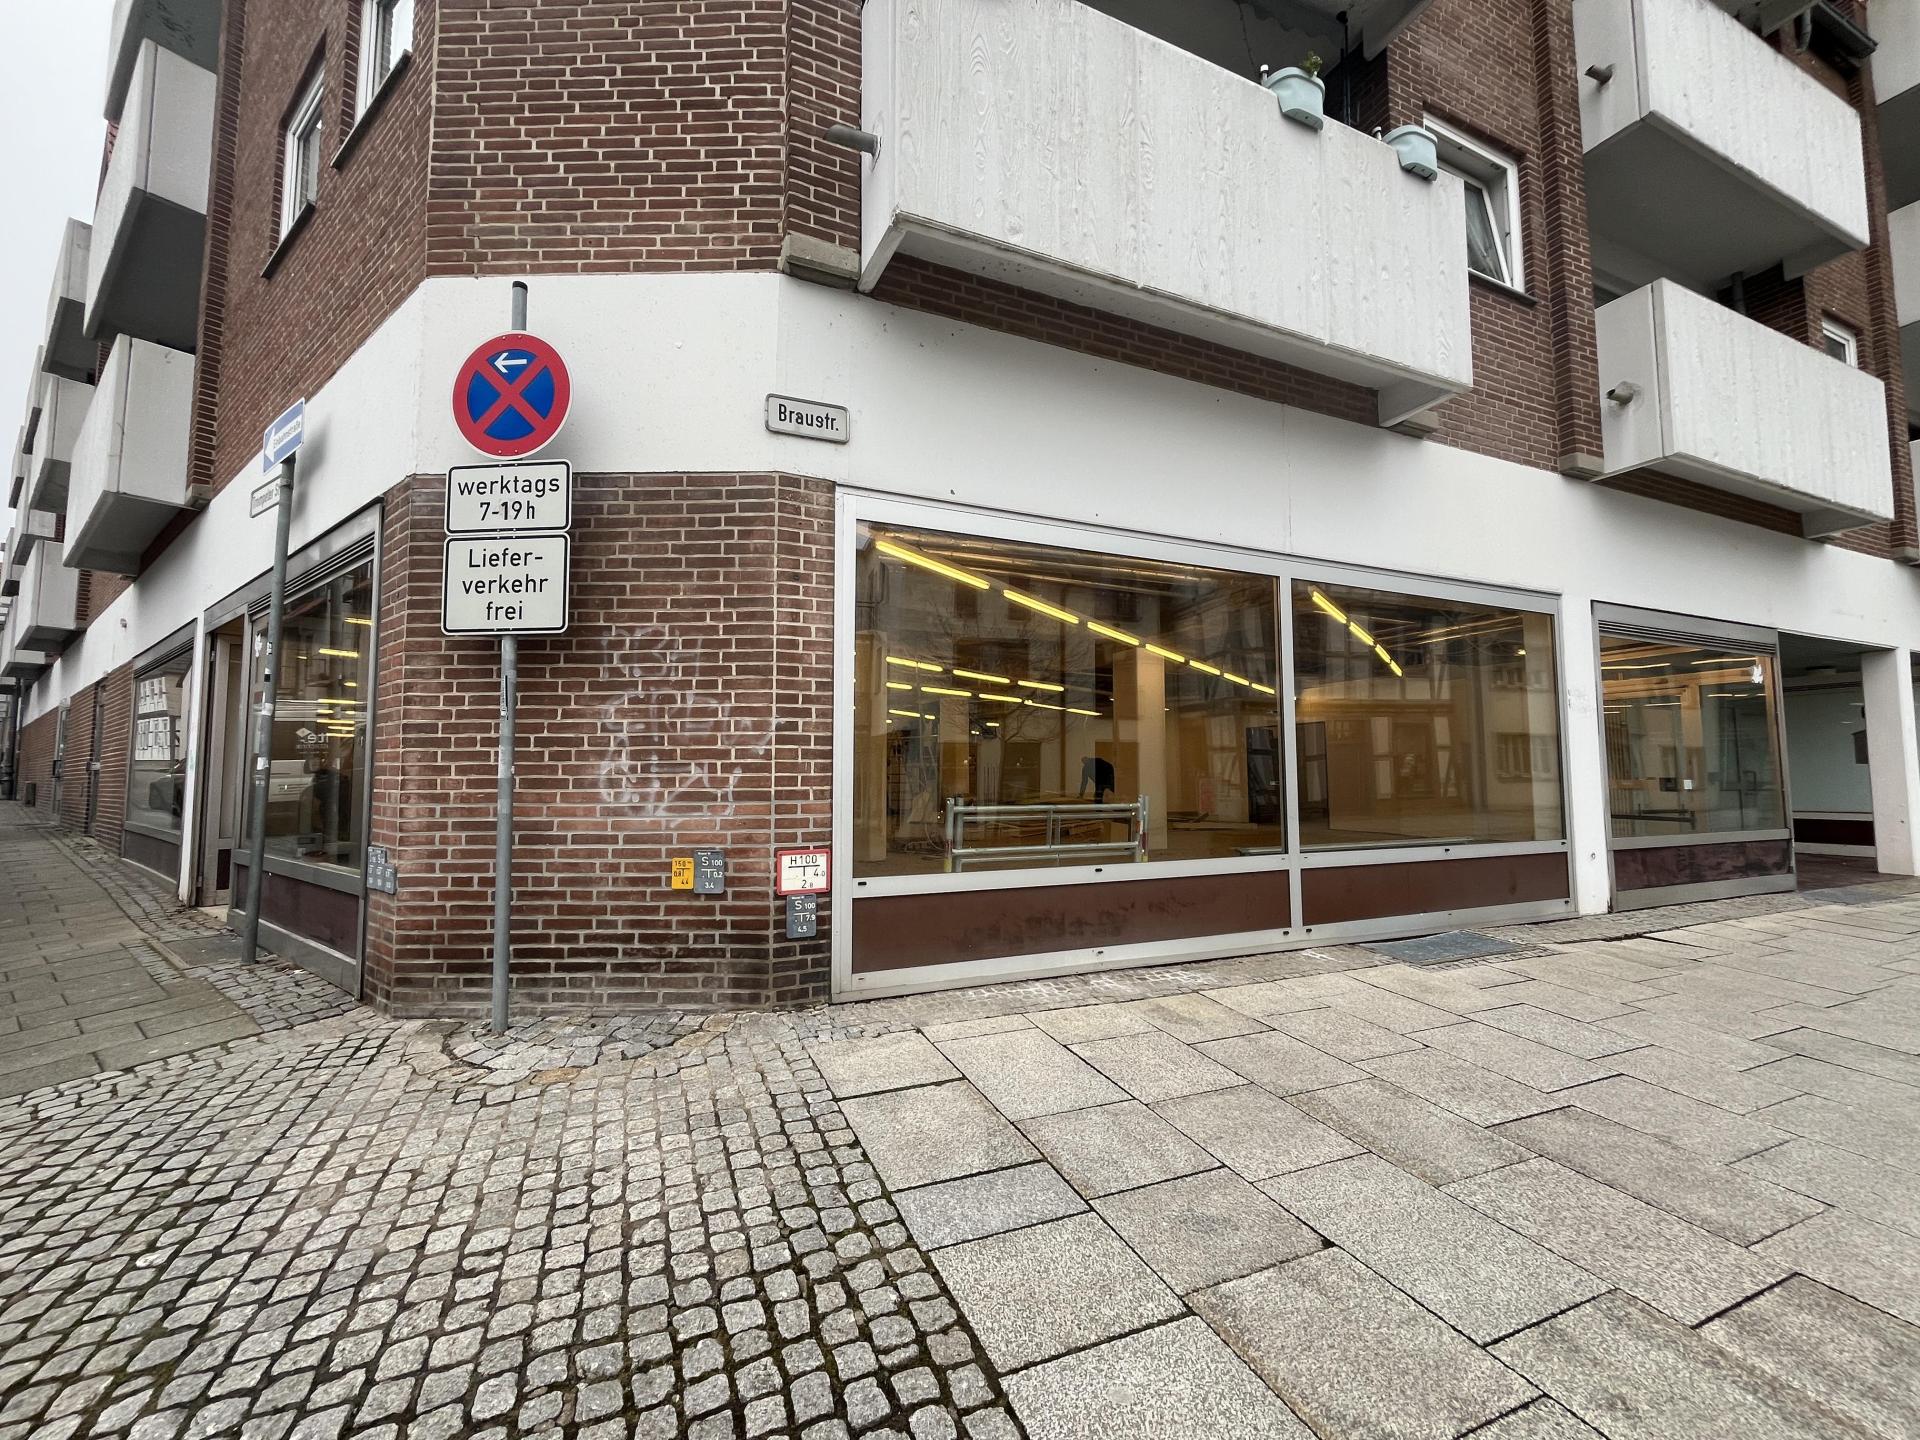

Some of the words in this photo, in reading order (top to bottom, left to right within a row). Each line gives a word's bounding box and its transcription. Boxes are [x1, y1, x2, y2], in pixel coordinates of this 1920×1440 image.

[778, 403, 839, 431] Braustr.
[458, 475, 560, 498] werktags
[468, 547, 543, 568] Liefer-
[462, 573, 549, 594] verkehr
[486, 600, 523, 621] frei
[701, 856, 709, 866] S
[795, 900, 802, 910] S
